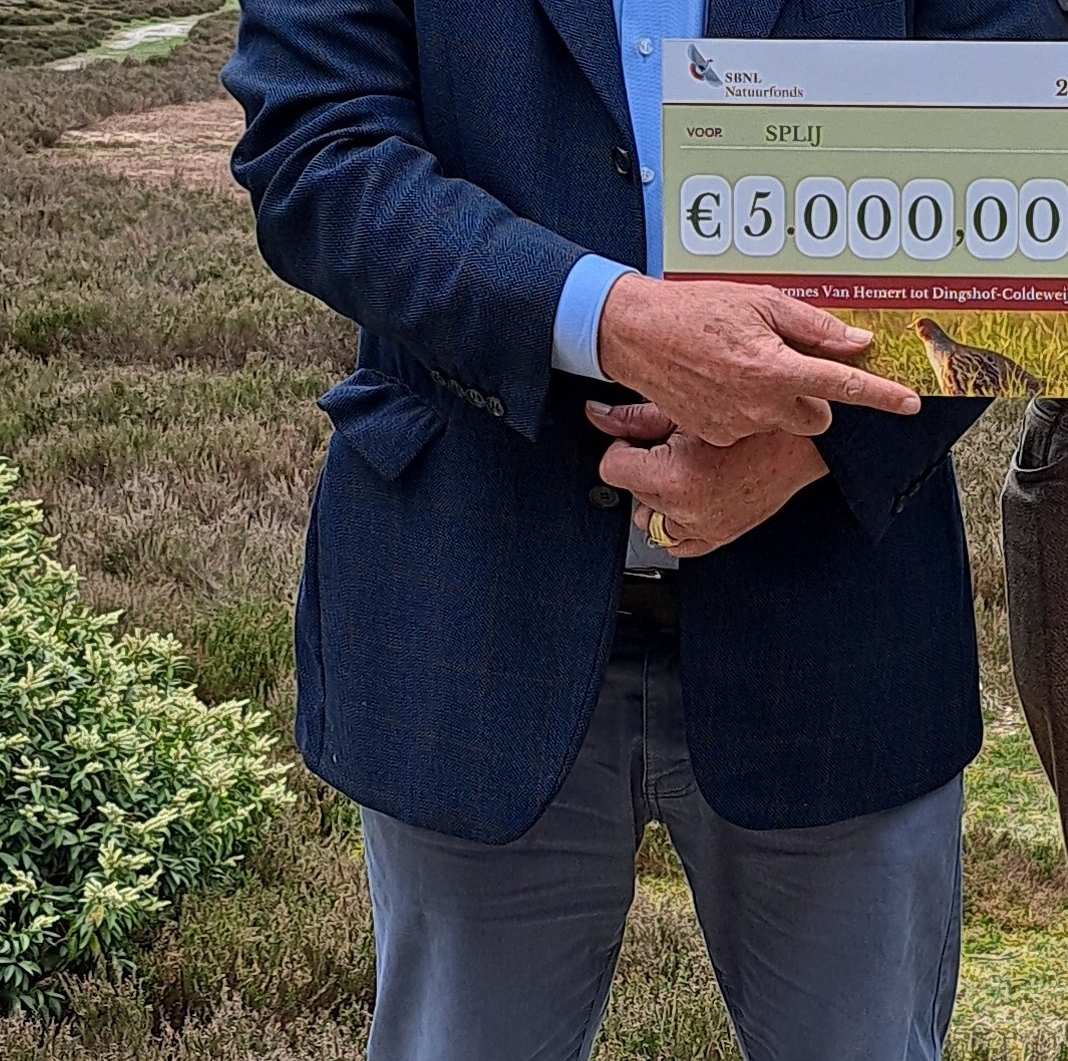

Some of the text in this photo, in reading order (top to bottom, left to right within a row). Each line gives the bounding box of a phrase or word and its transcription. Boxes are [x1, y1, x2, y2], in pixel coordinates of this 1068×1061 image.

[725, 72, 763, 84] SBNL
[725, 85, 804, 98] Natuurfonds
[686, 124, 824, 148] VOOR SPLIJ
[685, 190, 1061, 247] €5.000,00
[821, 284, 851, 300] Van
[853, 285, 908, 300] Hemert
[910, 285, 930, 301] tot
